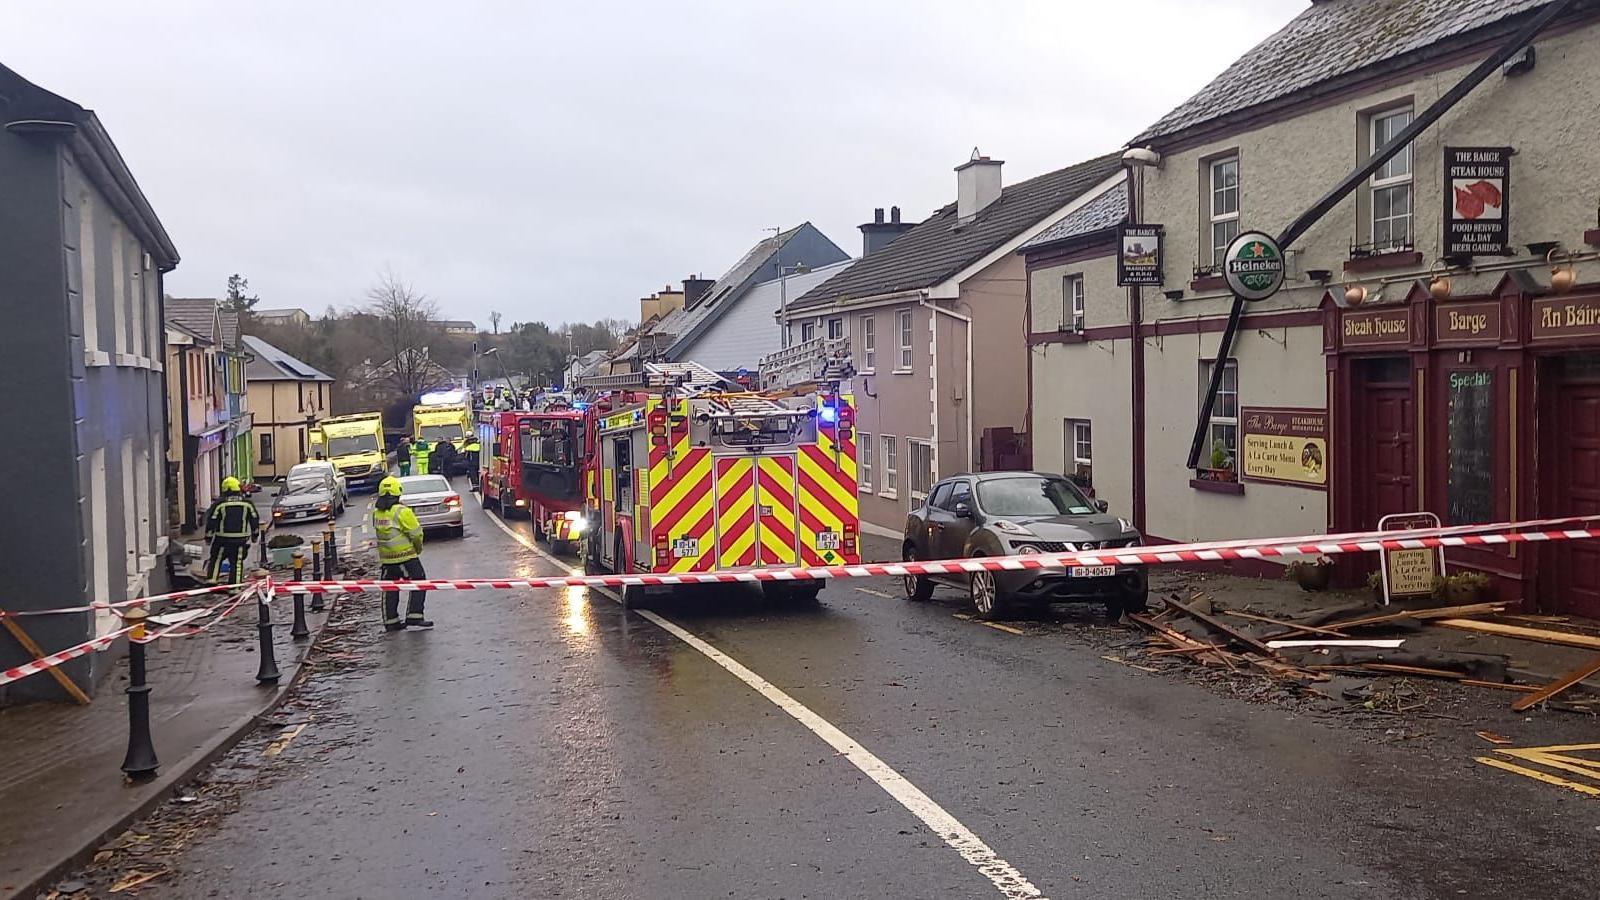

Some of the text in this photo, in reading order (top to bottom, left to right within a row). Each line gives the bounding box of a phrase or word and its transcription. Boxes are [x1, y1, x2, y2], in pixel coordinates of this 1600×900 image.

[1456, 152, 1500, 162] THE BARGE
[1451, 166, 1504, 177] STEAK HOUSE
[1452, 224, 1502, 232] FOOD SERVED
[1462, 233, 1492, 242] ALL DAY
[1452, 243, 1501, 252] BEER GARDEN
[1232, 260, 1280, 272] Heineken
[1542, 306, 1560, 328] An
[1345, 318, 1372, 336] Steak
[1450, 312, 1487, 334] Barge
[1450, 372, 1491, 393] Specials
[1247, 416, 1261, 428] The
[1248, 440, 1293, 450] Serving Lunch &
[1262, 452, 1278, 461] Carte
[1280, 453, 1295, 463] Menu
[1248, 464, 1275, 475] Every Day
